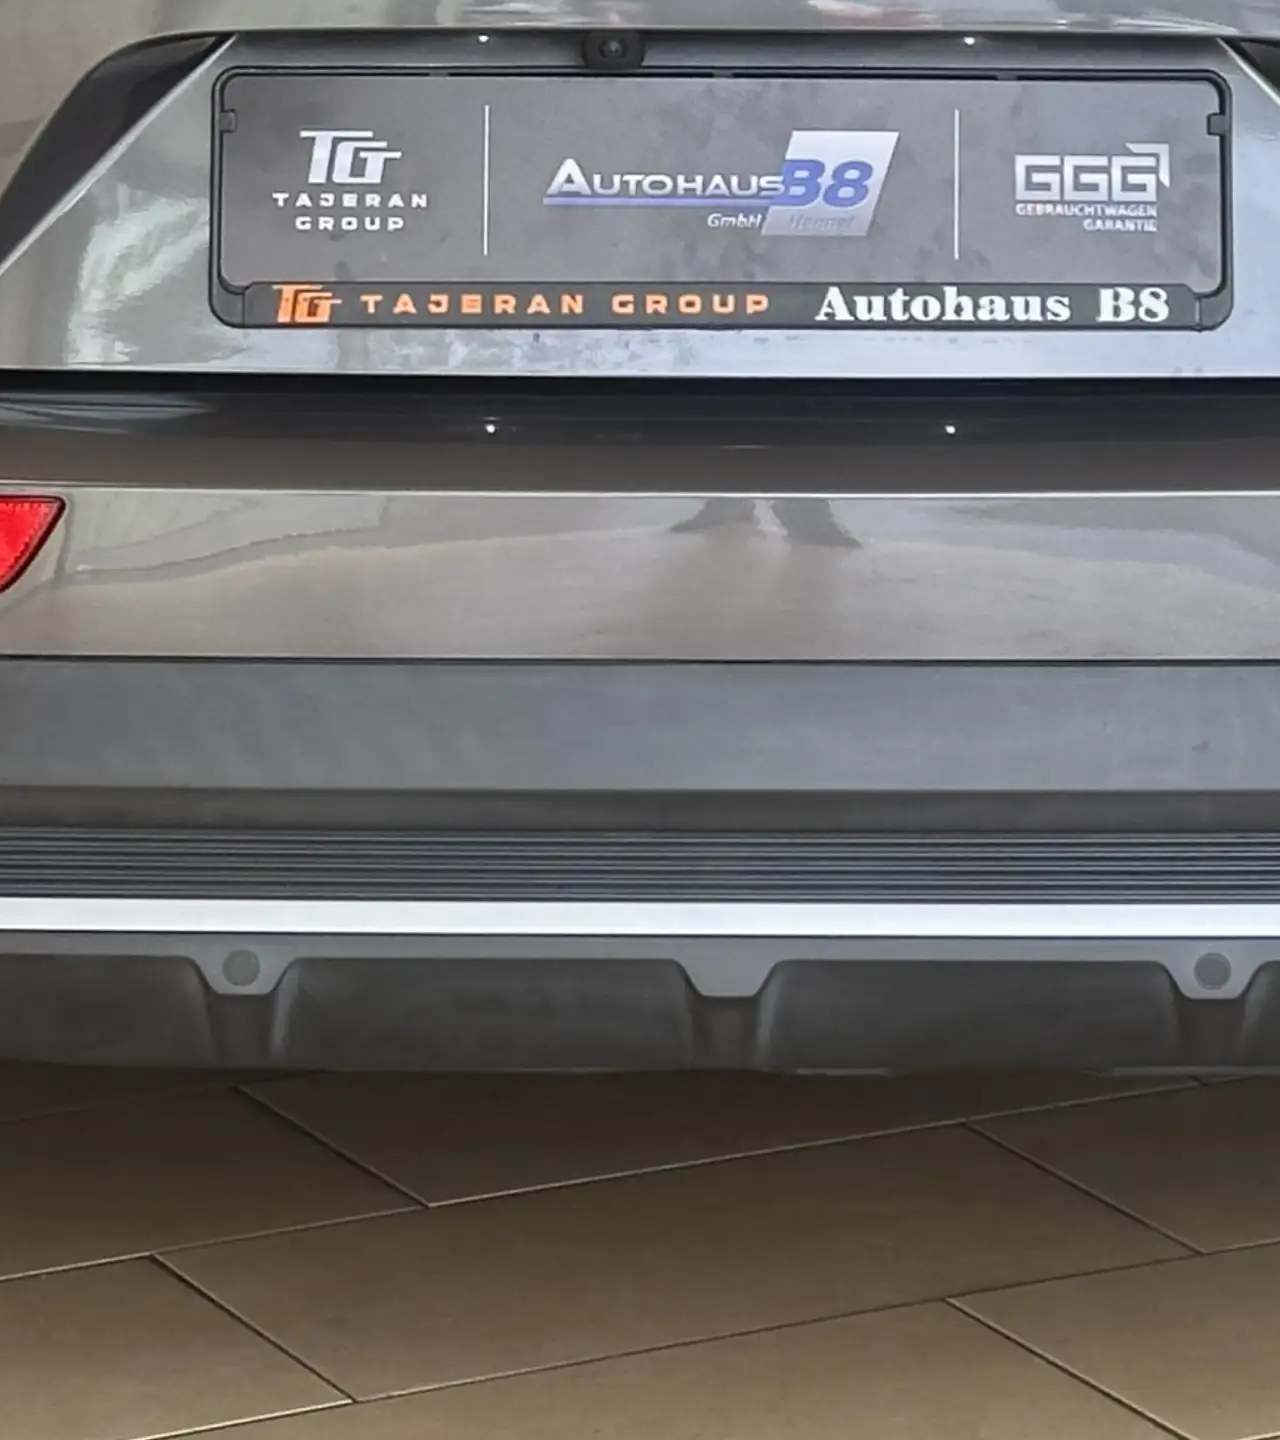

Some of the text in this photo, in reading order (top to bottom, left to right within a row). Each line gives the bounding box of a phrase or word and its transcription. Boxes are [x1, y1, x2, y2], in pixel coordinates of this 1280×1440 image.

[1014, 154, 1157, 202] GGG
[272, 192, 428, 208] TAJERAN
[1015, 203, 1157, 218] GEBRAUCHTWAGEN
[295, 215, 405, 231] GROUP
[707, 212, 762, 230] GmbH
[1083, 218, 1157, 233] GARANTIE
[360, 293, 584, 315] TAJERAN
[611, 294, 769, 315] GROUP
[814, 286, 1072, 323] Autohaus
[1095, 287, 1170, 324] B8
